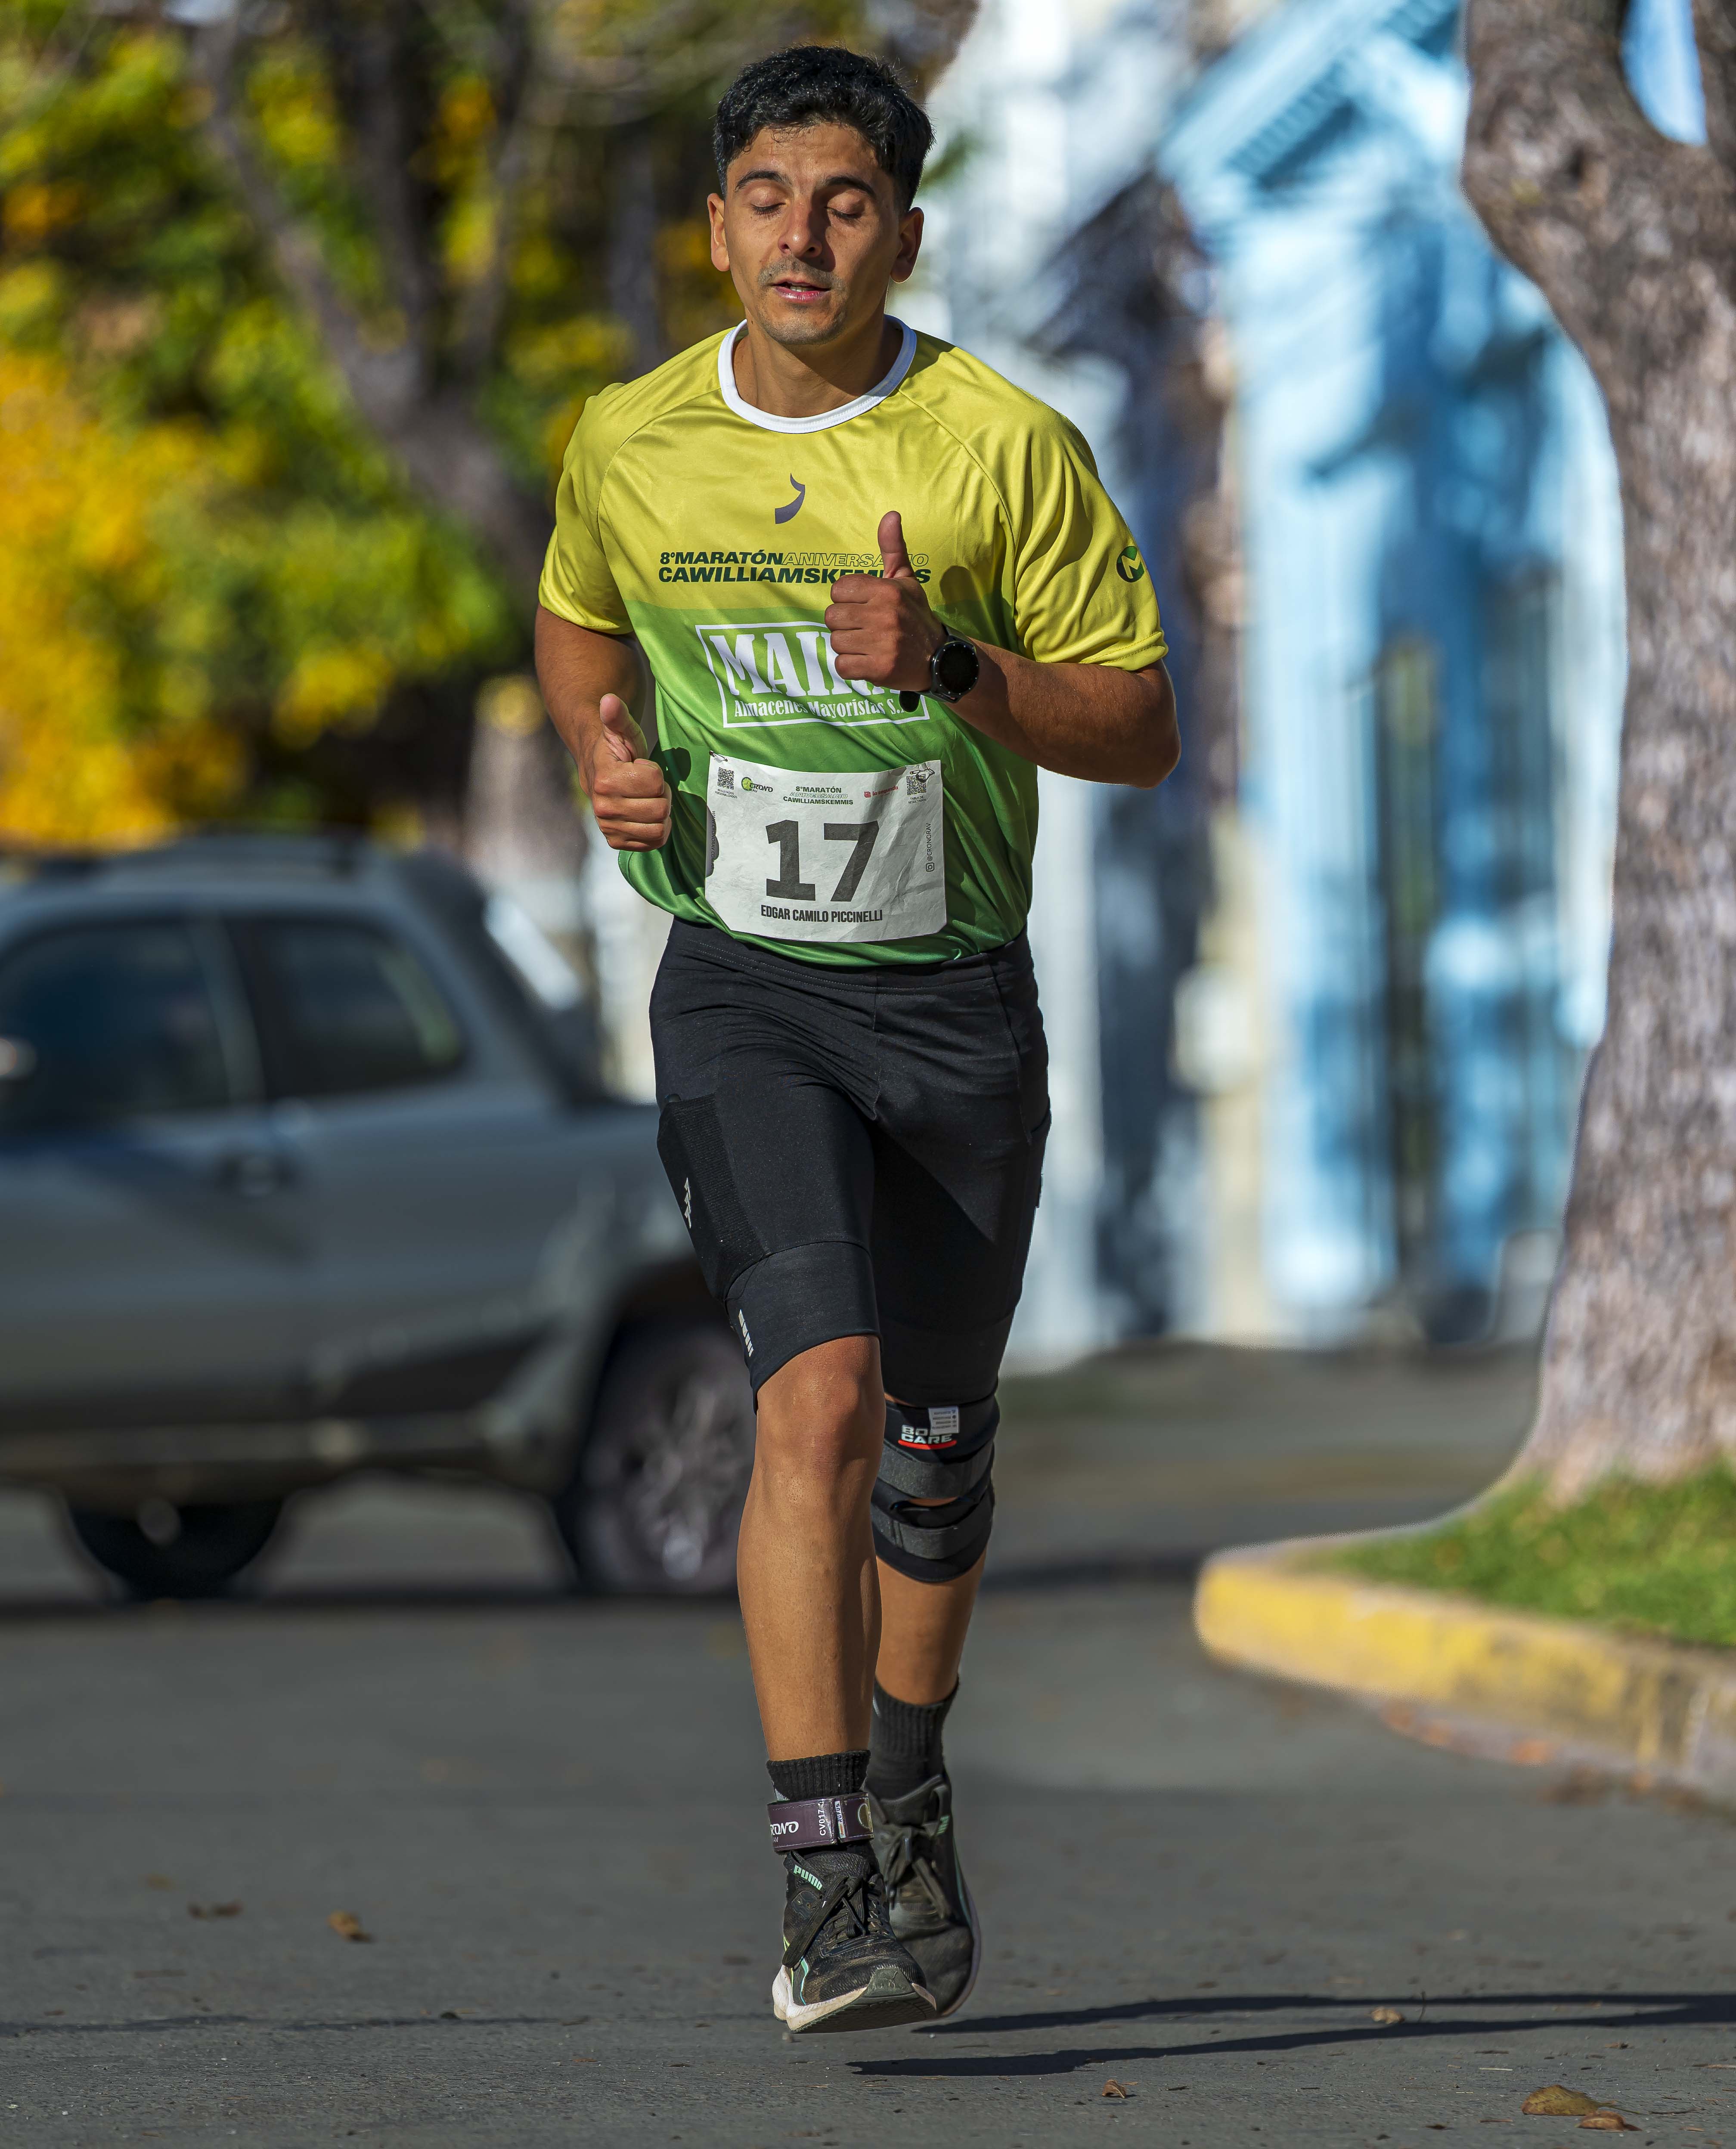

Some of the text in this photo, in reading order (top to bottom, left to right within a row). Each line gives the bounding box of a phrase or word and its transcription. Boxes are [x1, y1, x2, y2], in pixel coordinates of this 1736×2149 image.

[734, 699, 808, 718] Almacenes
[808, 697, 886, 718] Mayoristas
[749, 783, 773, 793] CRONO
[783, 796, 853, 805] CAWILLIAMSKEMMIS
[766, 819, 880, 902] 17
[761, 904, 883, 923] EDGAR CAMILO PICCINELLI
[901, 1434, 952, 1444] CARE
[770, 1821, 799, 1836] RONO
[794, 1864, 823, 1891] PUMA
